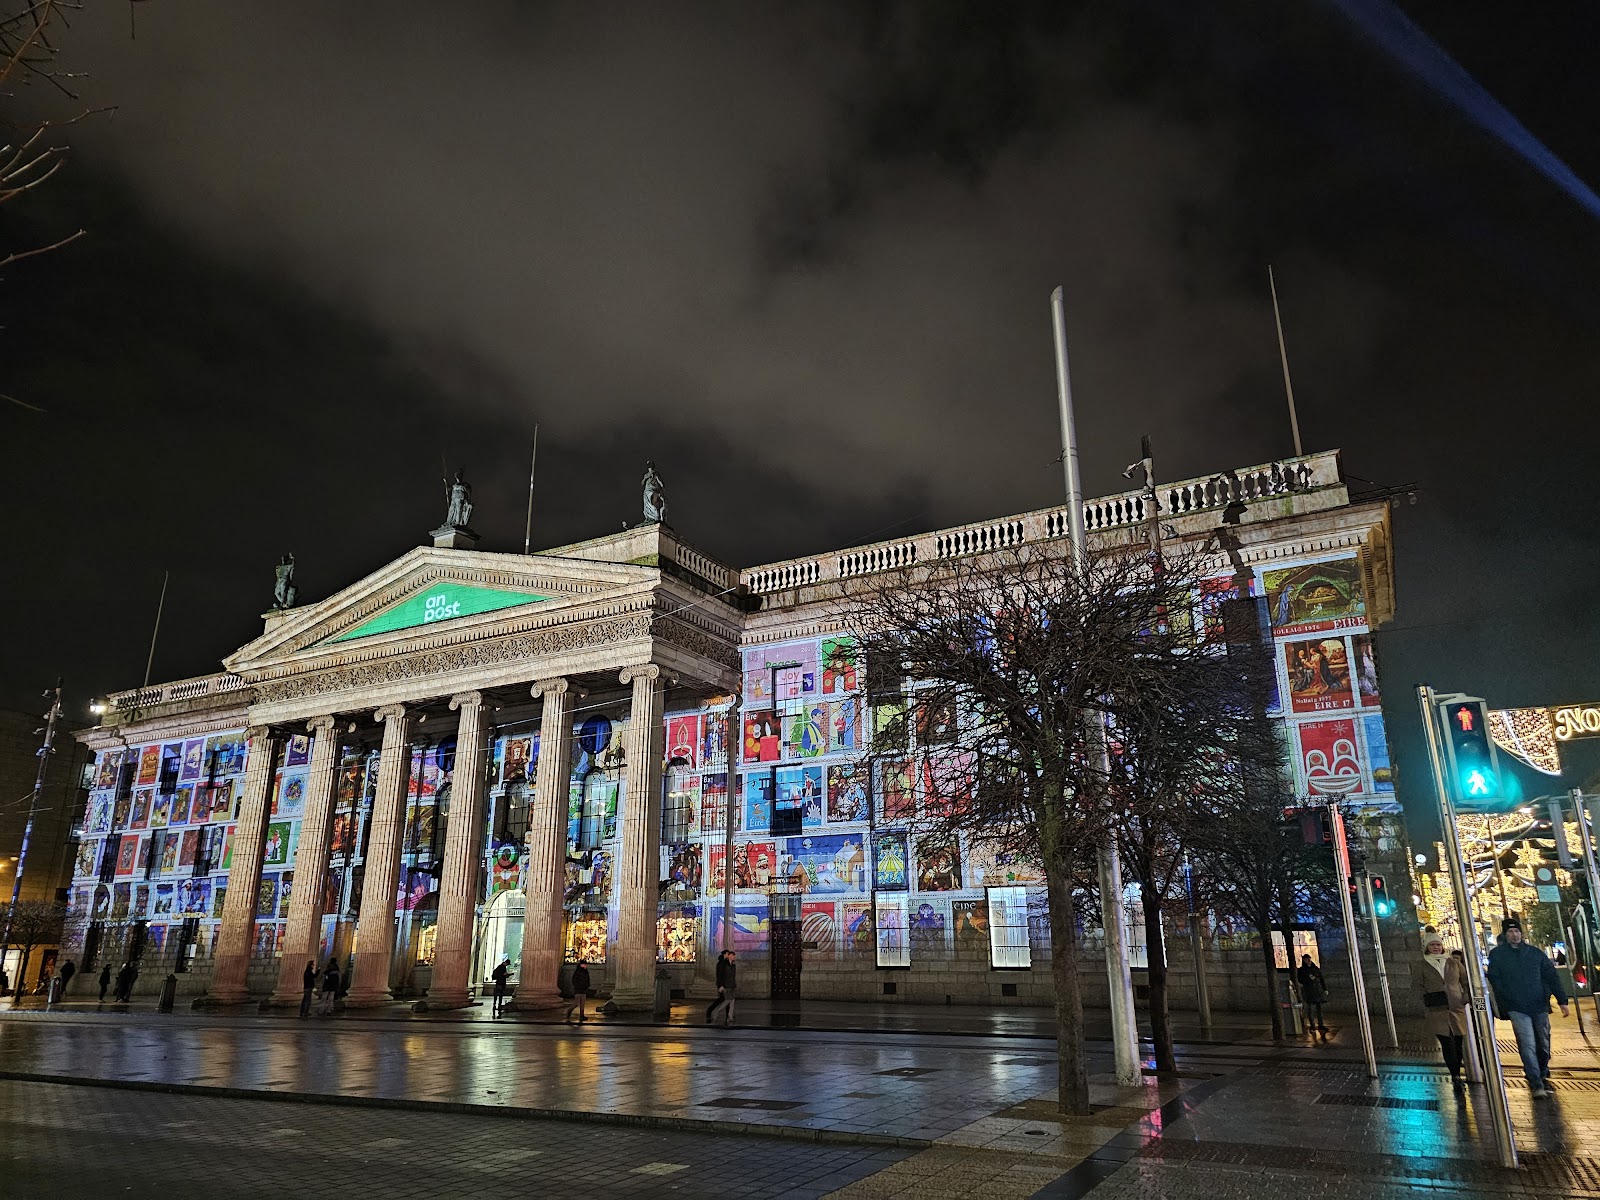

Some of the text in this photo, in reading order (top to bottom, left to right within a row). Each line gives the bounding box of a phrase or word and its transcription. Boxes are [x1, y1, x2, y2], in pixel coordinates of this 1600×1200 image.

[426, 594, 446, 609] an
[424, 600, 461, 623] post
[1333, 616, 1366, 629] EIRE
[1315, 699, 1351, 710] EIRE 17
[765, 844, 775, 852] 32
